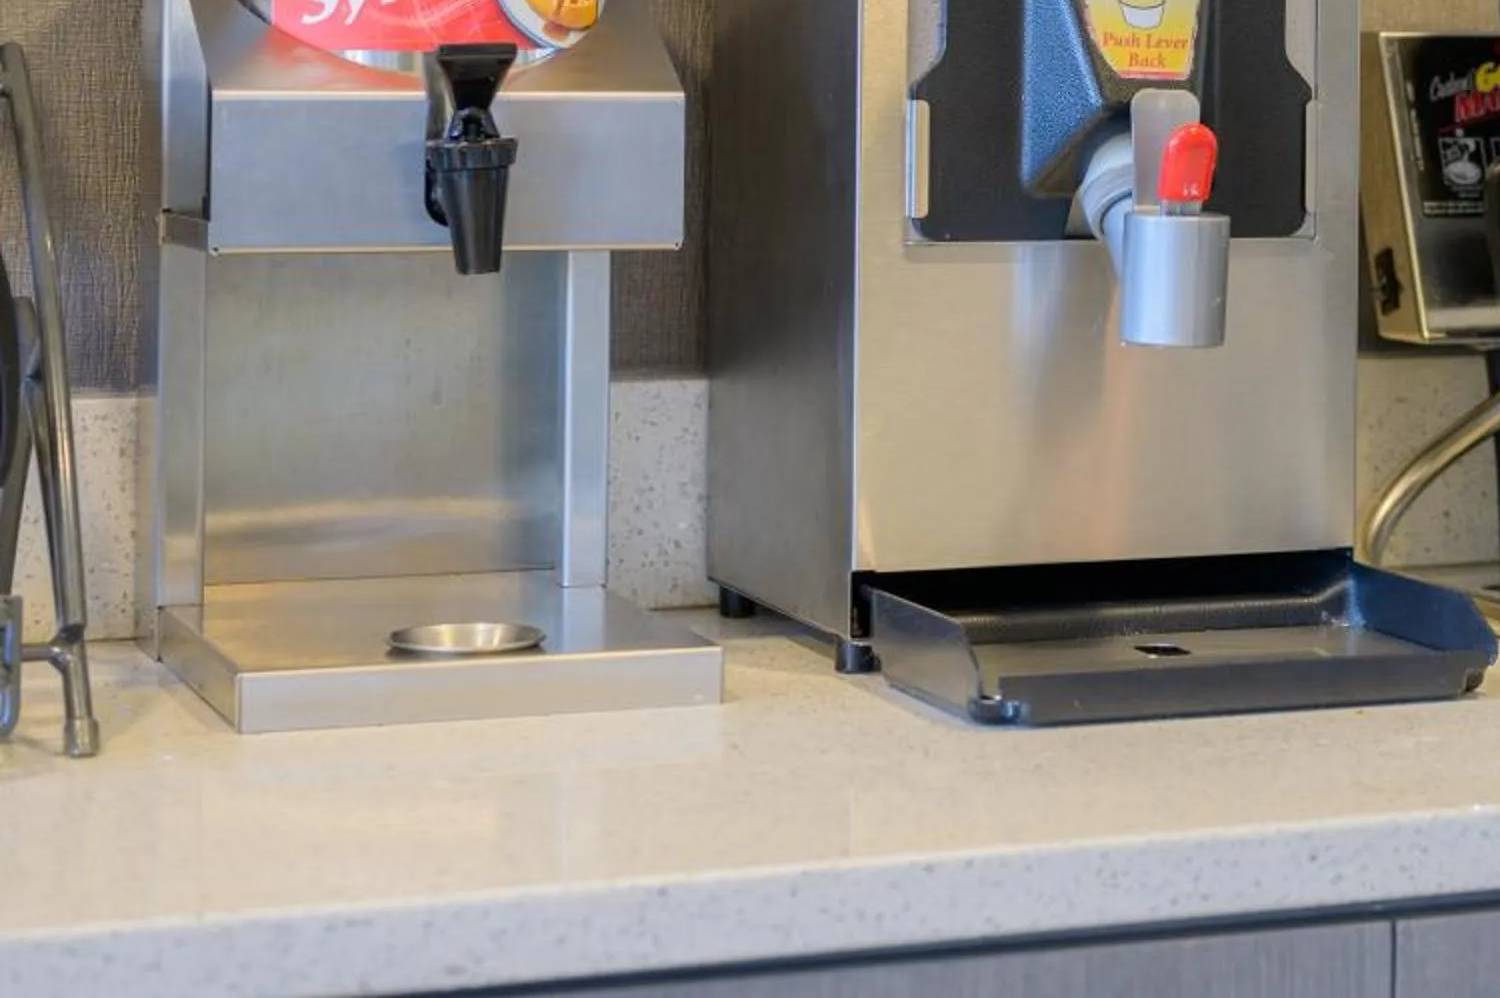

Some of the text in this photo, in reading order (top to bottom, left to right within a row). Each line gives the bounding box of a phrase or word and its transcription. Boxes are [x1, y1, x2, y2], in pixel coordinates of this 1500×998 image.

[1103, 31, 1189, 50] Push Lever
[1128, 53, 1167, 69] Back
